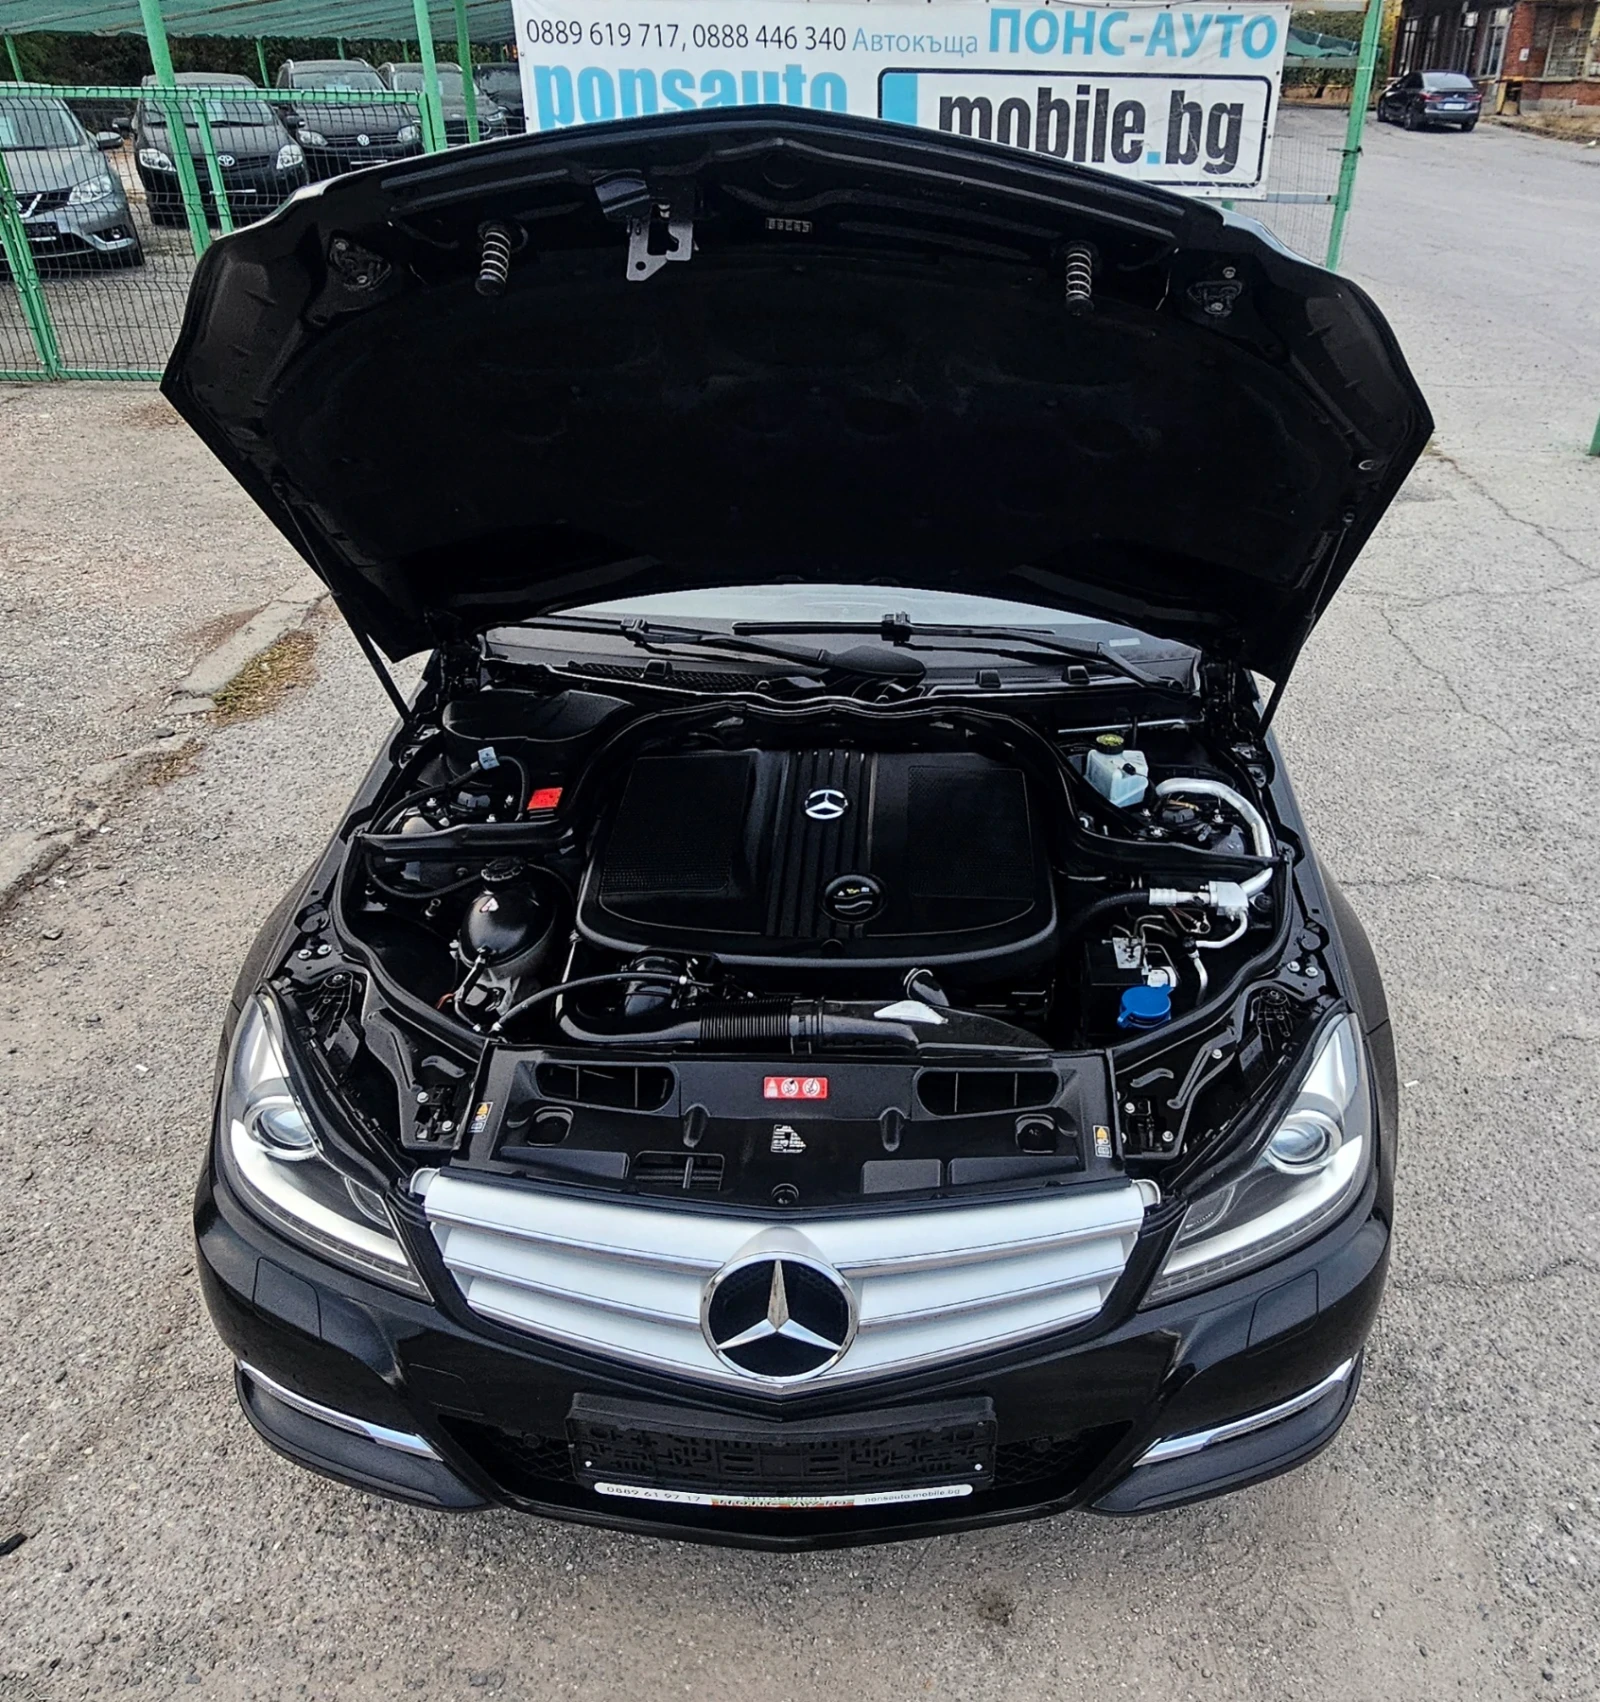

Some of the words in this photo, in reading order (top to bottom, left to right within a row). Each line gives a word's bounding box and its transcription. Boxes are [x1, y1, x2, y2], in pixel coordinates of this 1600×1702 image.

[526, 19, 583, 45] 0889
[589, 22, 631, 47] 619
[638, 23, 687, 52] 717,
[692, 23, 749, 48] 0888
[755, 24, 798, 50] 446
[805, 26, 847, 51] 340
[852, 27, 978, 58] Автокъща
[989, 8, 1278, 60] ПОНС-АУТО
[939, 84, 1244, 175] mobile.bg
